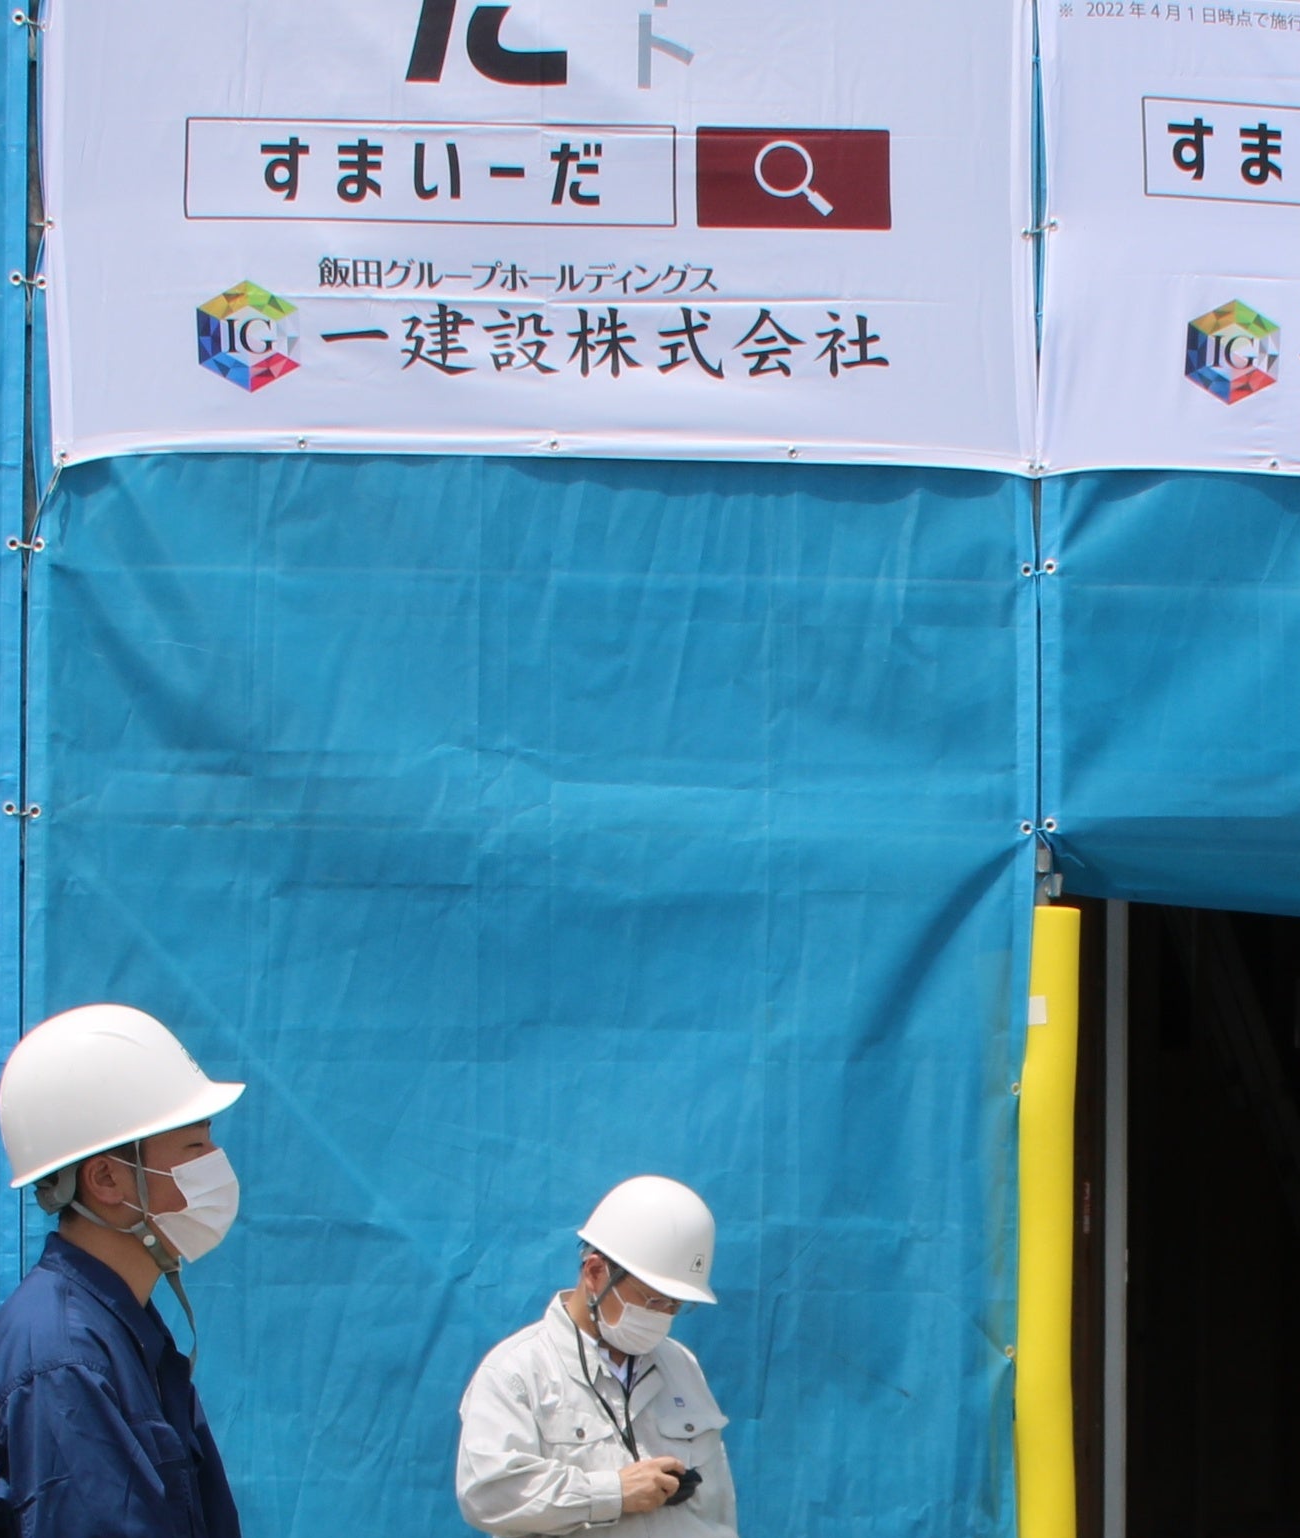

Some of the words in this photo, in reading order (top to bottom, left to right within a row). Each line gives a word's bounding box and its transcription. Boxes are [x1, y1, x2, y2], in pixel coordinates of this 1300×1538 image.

[260, 136, 603, 206] すまいーだ
[317, 256, 719, 295] 飯田グループホールディングス
[224, 317, 274, 355] IG
[319, 303, 891, 380] 一建設株式会社
[1211, 334, 1255, 372] IG
